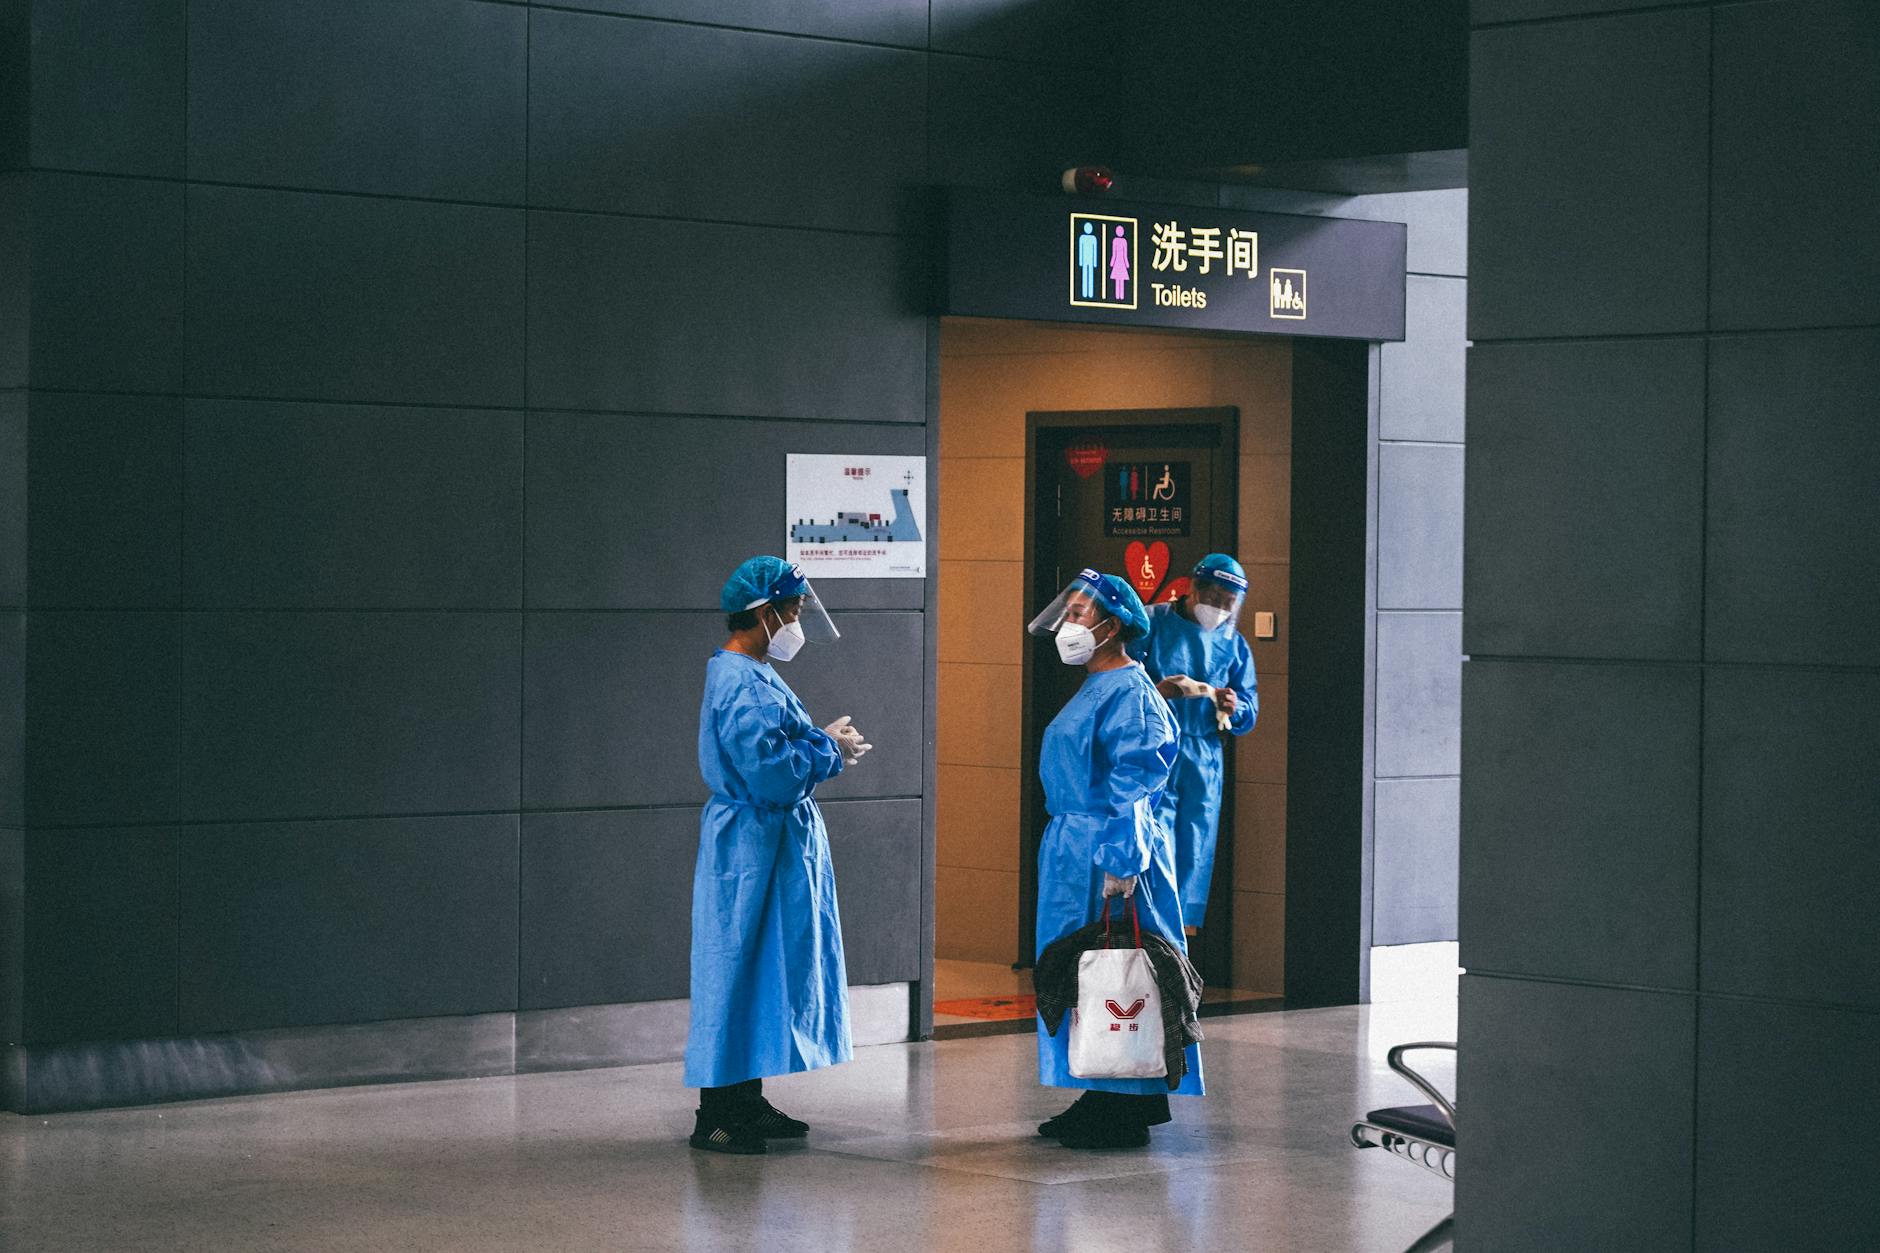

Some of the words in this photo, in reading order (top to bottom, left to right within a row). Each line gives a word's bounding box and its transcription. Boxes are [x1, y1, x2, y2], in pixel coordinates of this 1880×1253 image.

[1151, 220, 1258, 279] 洗手间
[1151, 283, 1207, 309] Toilets
[1112, 506, 1182, 522] 无障碍卫生间
